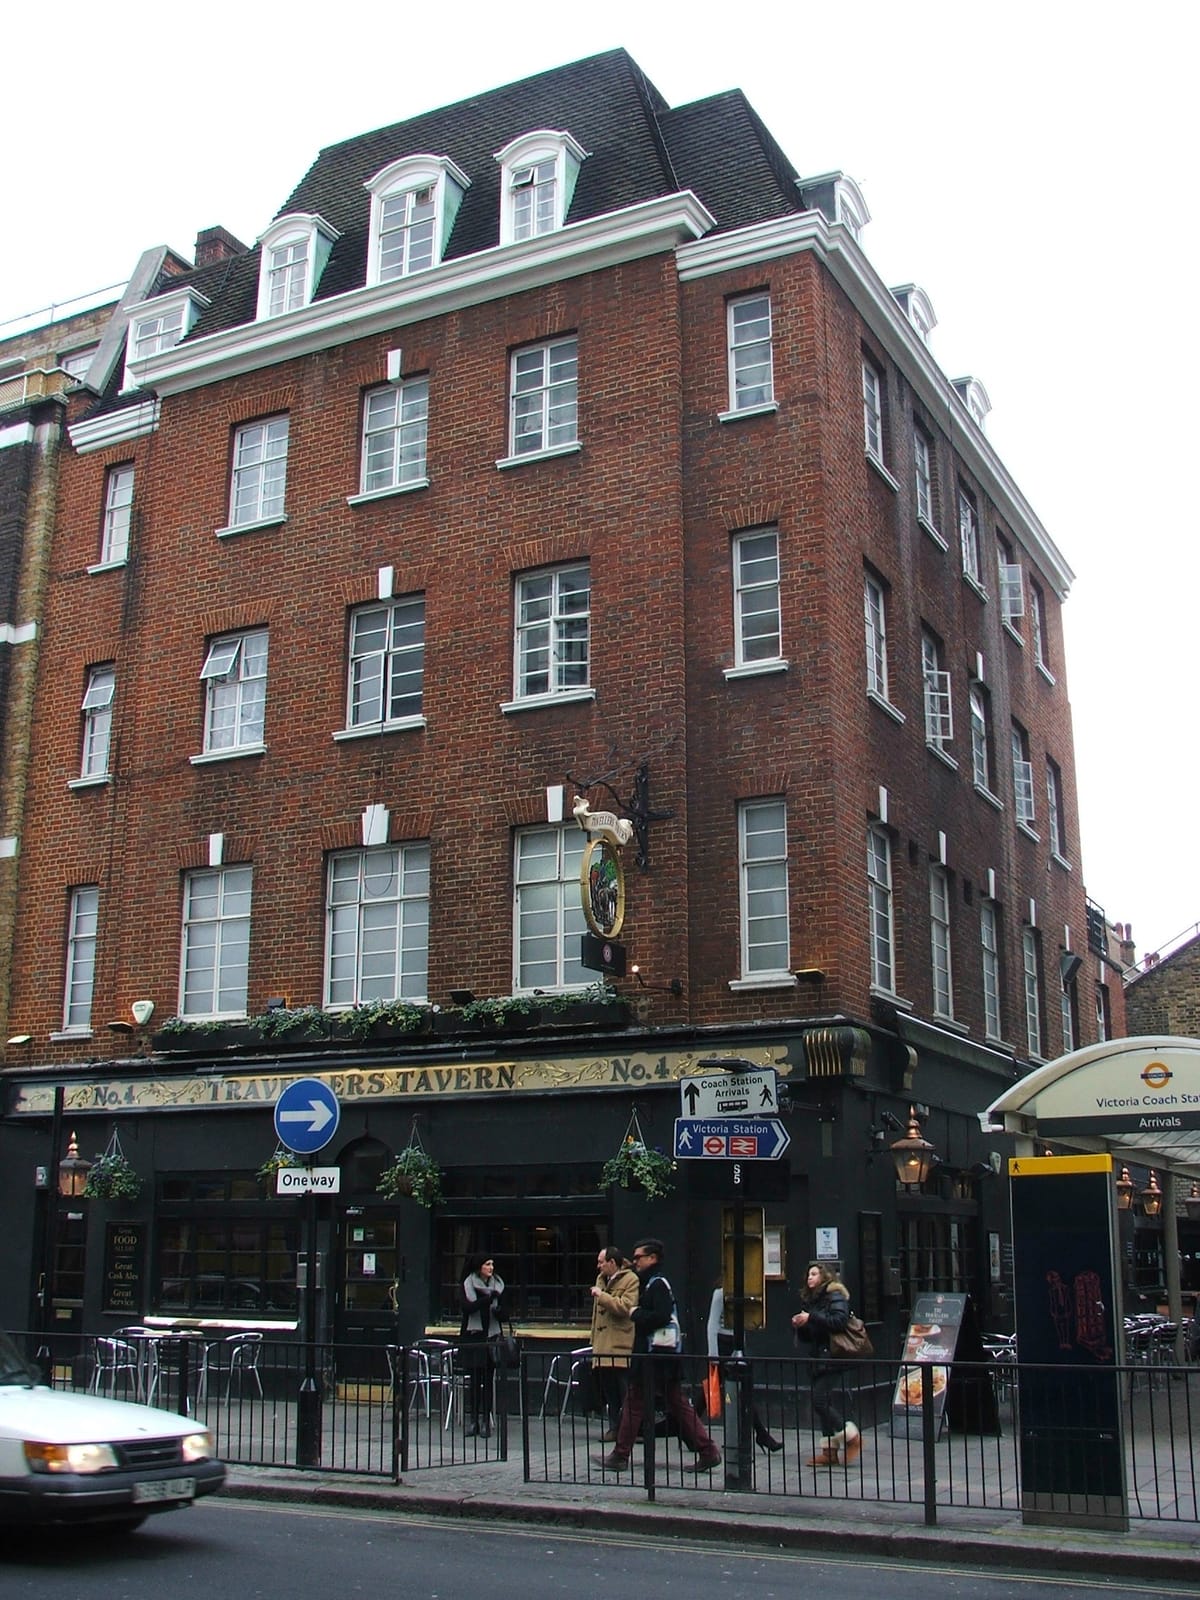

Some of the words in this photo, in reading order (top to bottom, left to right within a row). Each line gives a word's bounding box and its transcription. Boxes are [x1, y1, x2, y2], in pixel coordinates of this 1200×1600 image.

[207, 1072, 385, 1101] TRAVERS
[397, 1065, 516, 1092] TAVERN
[701, 1080, 728, 1089] Coach
[731, 1077, 763, 1087] Station
[92, 1085, 135, 1107] No.4
[715, 1087, 750, 1098] Arrivals
[1096, 1097, 1139, 1107] Victoria
[1142, 1094, 1178, 1106] Coach
[1181, 1094, 1200, 1103] Sta
[1139, 1116, 1181, 1128] Arrivals
[693, 1124, 729, 1134] Victoria
[733, 1124, 768, 1134] Station
[282, 1174, 308, 1186] One
[310, 1176, 335, 1188] way
